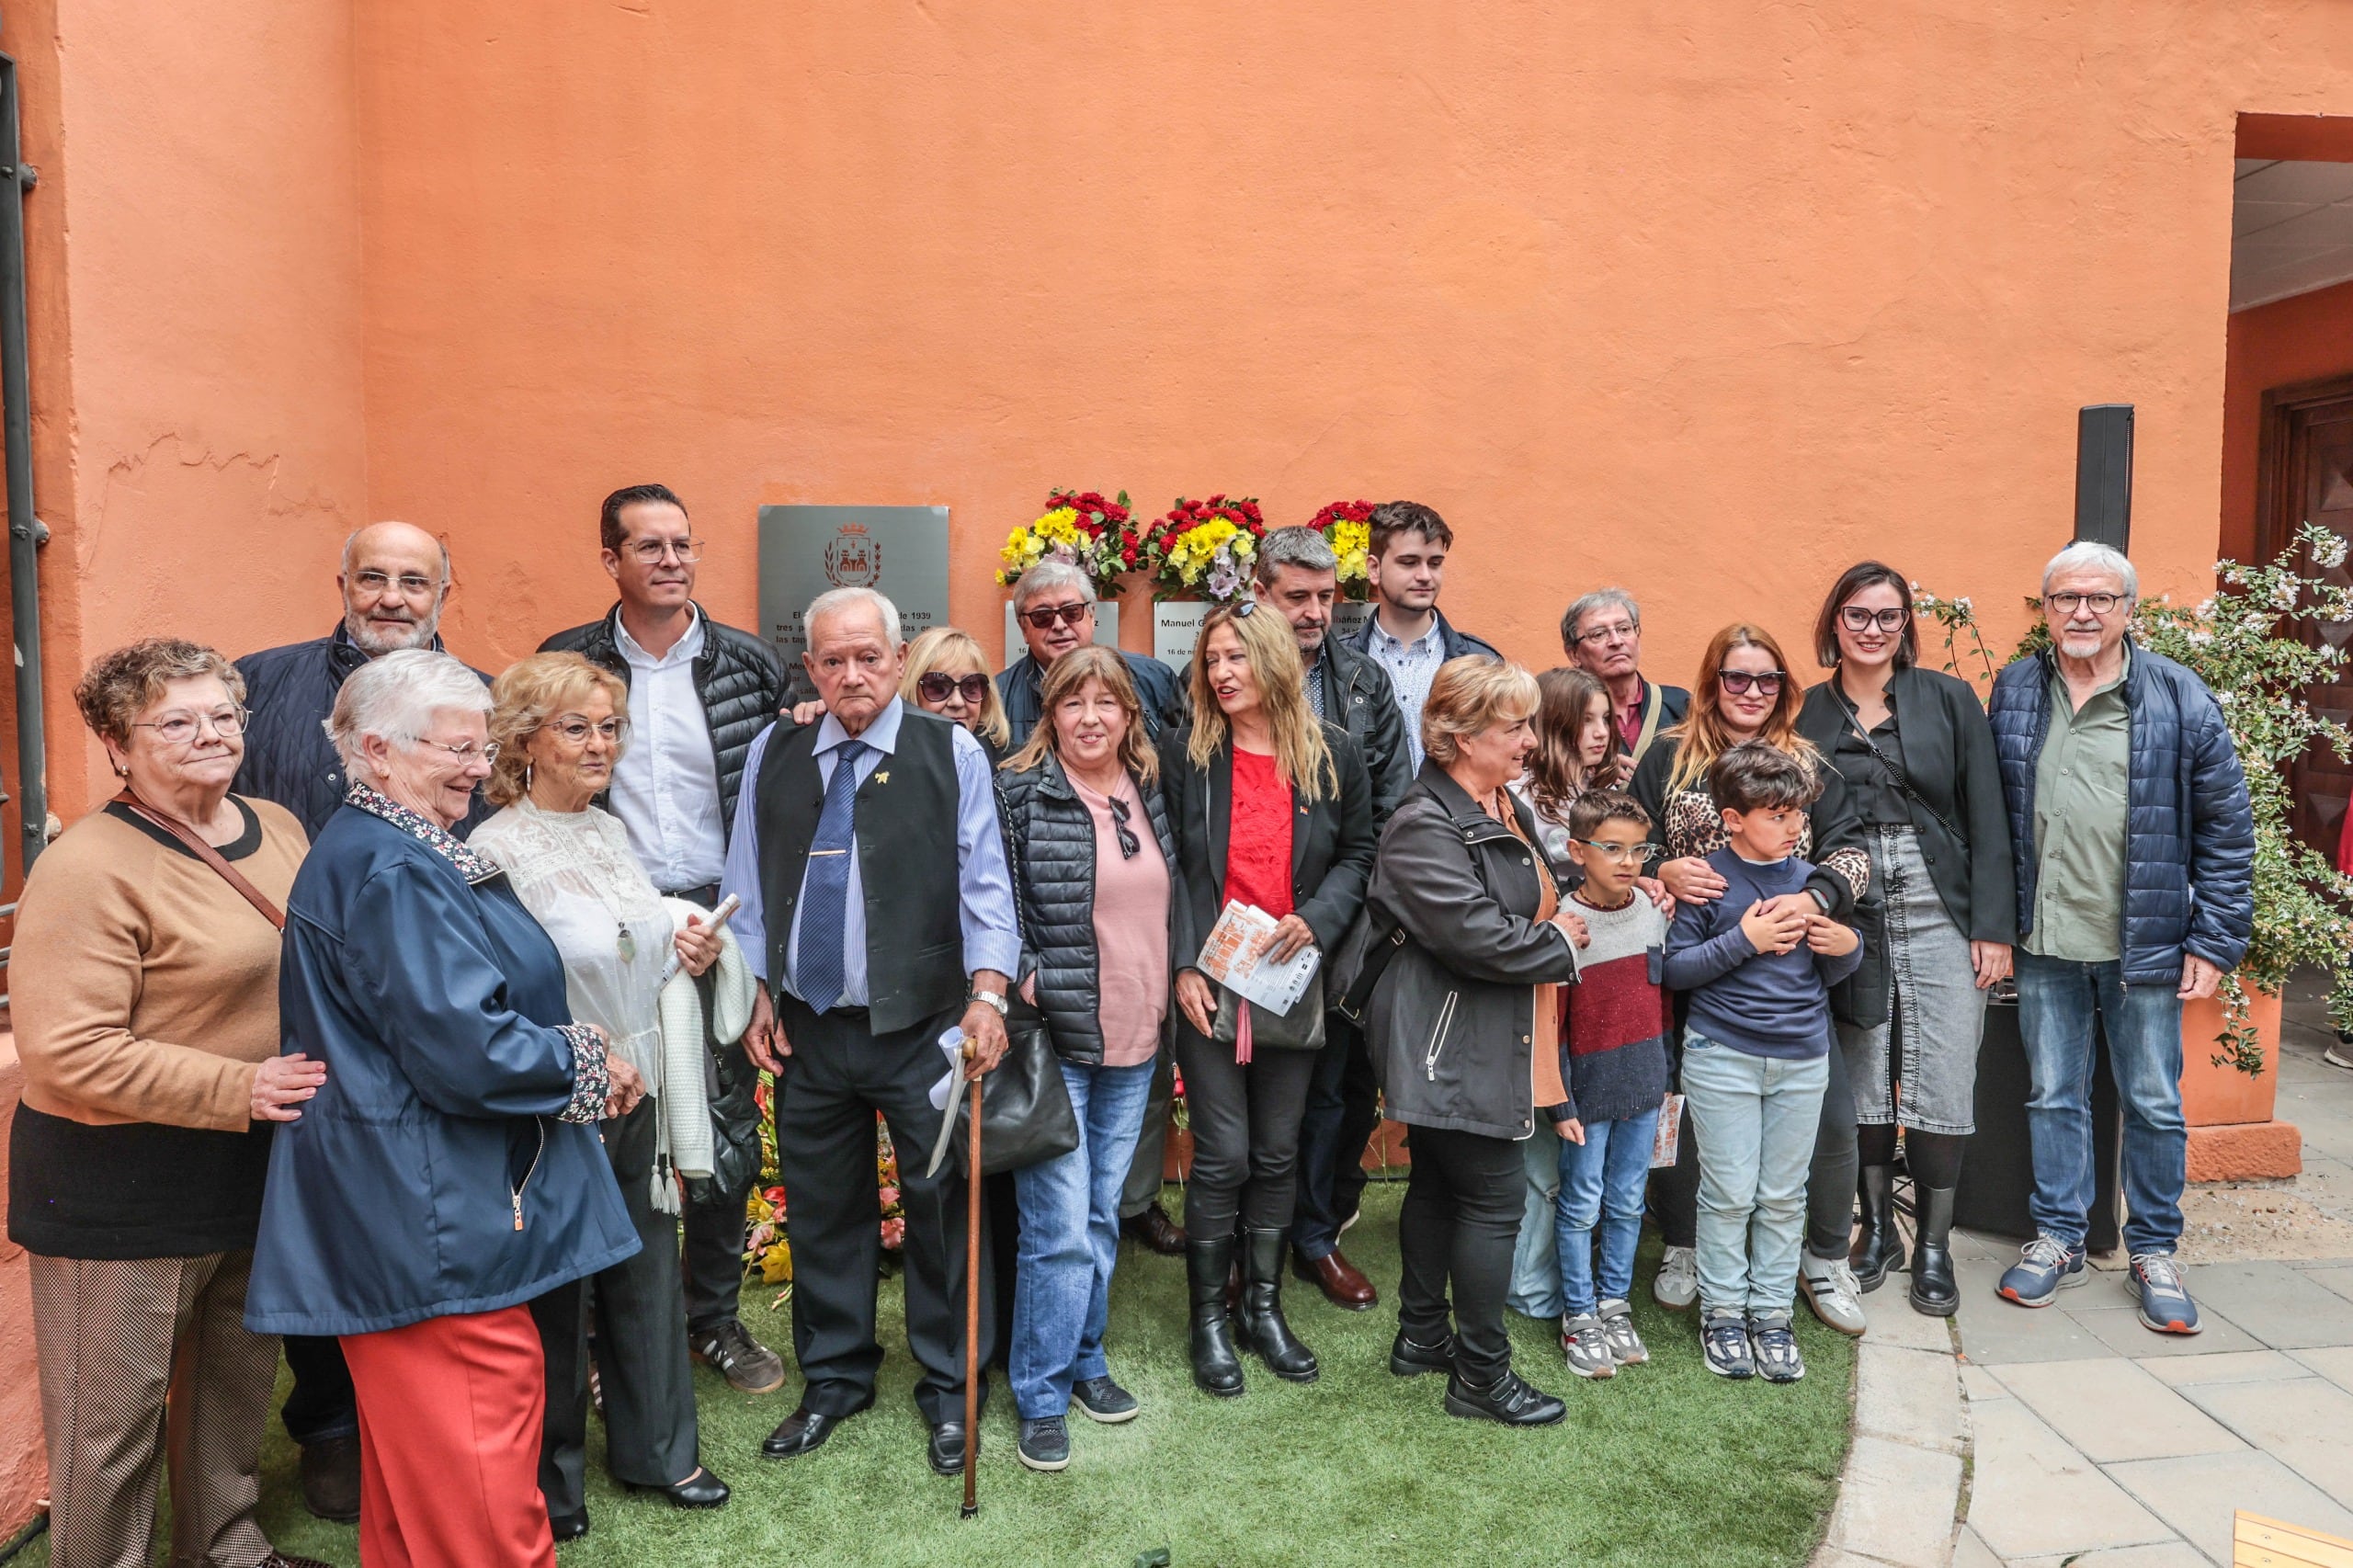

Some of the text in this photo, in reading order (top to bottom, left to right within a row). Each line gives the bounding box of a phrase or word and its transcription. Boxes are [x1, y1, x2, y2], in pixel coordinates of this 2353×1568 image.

[792, 610, 801, 619] El
[911, 611, 931, 619] 1939
[1161, 619, 1195, 627] Manuel
[1176, 647, 1186, 655] de
